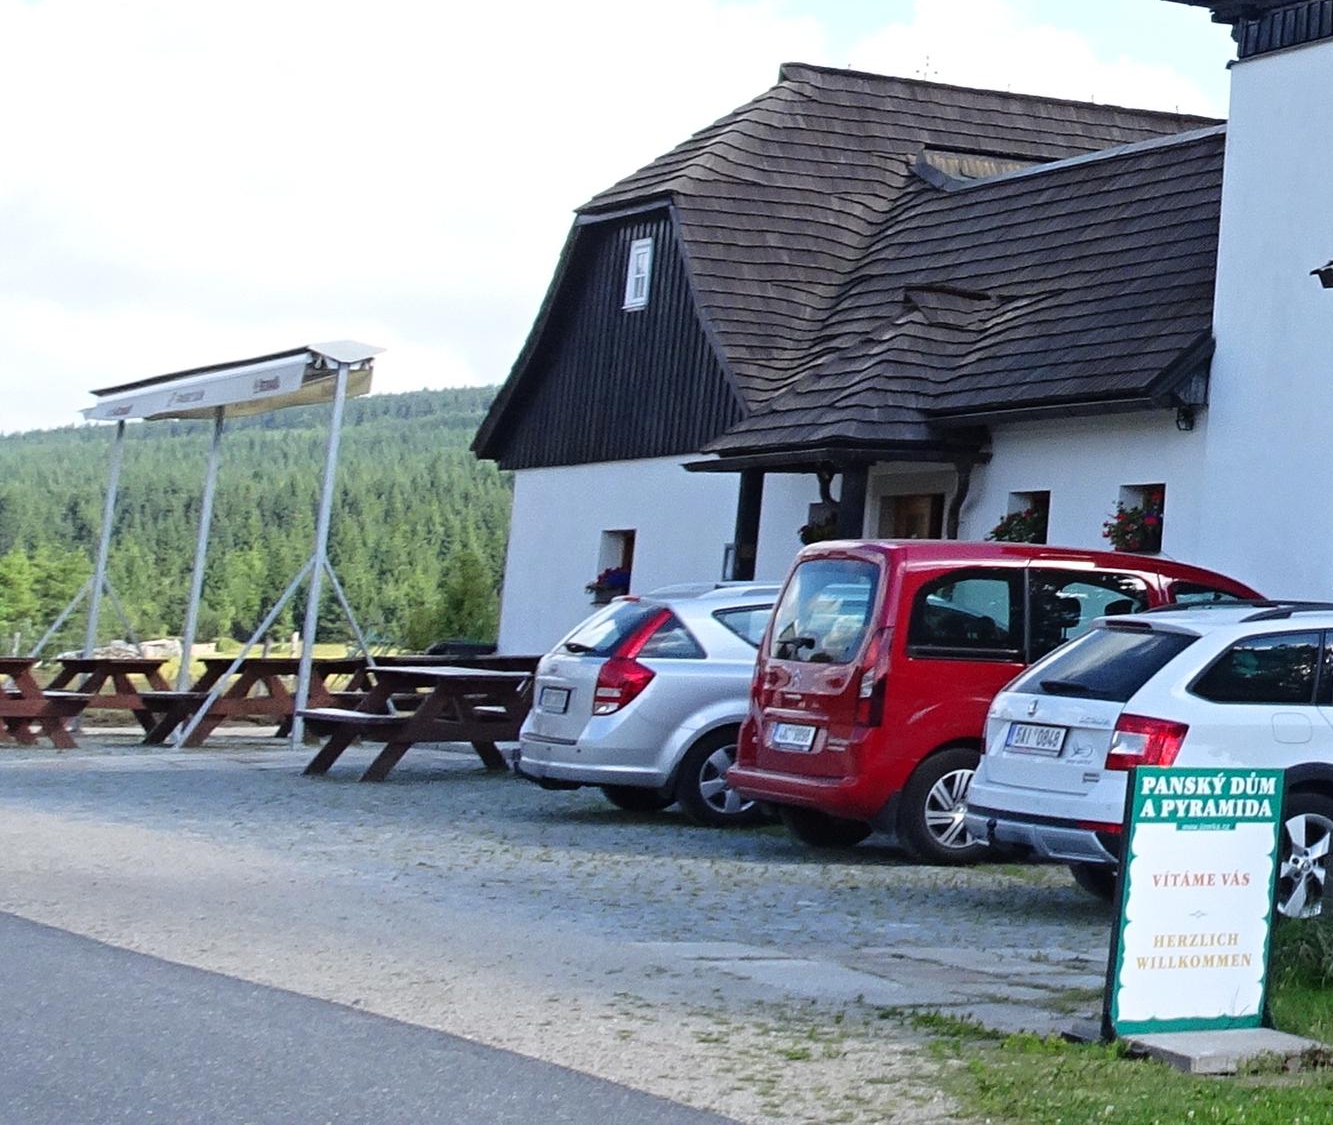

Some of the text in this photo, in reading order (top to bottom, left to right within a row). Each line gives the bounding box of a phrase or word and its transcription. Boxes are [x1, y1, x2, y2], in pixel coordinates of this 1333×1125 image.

[1140, 772, 1226, 795] PANSKÝ
[1139, 798, 1272, 817] A PYRAMIDA
[1152, 869, 1250, 887] VÍTÁME VÁS
[1153, 933, 1239, 948] HERZLICH
[1136, 953, 1252, 970] WILLKOMMEN
